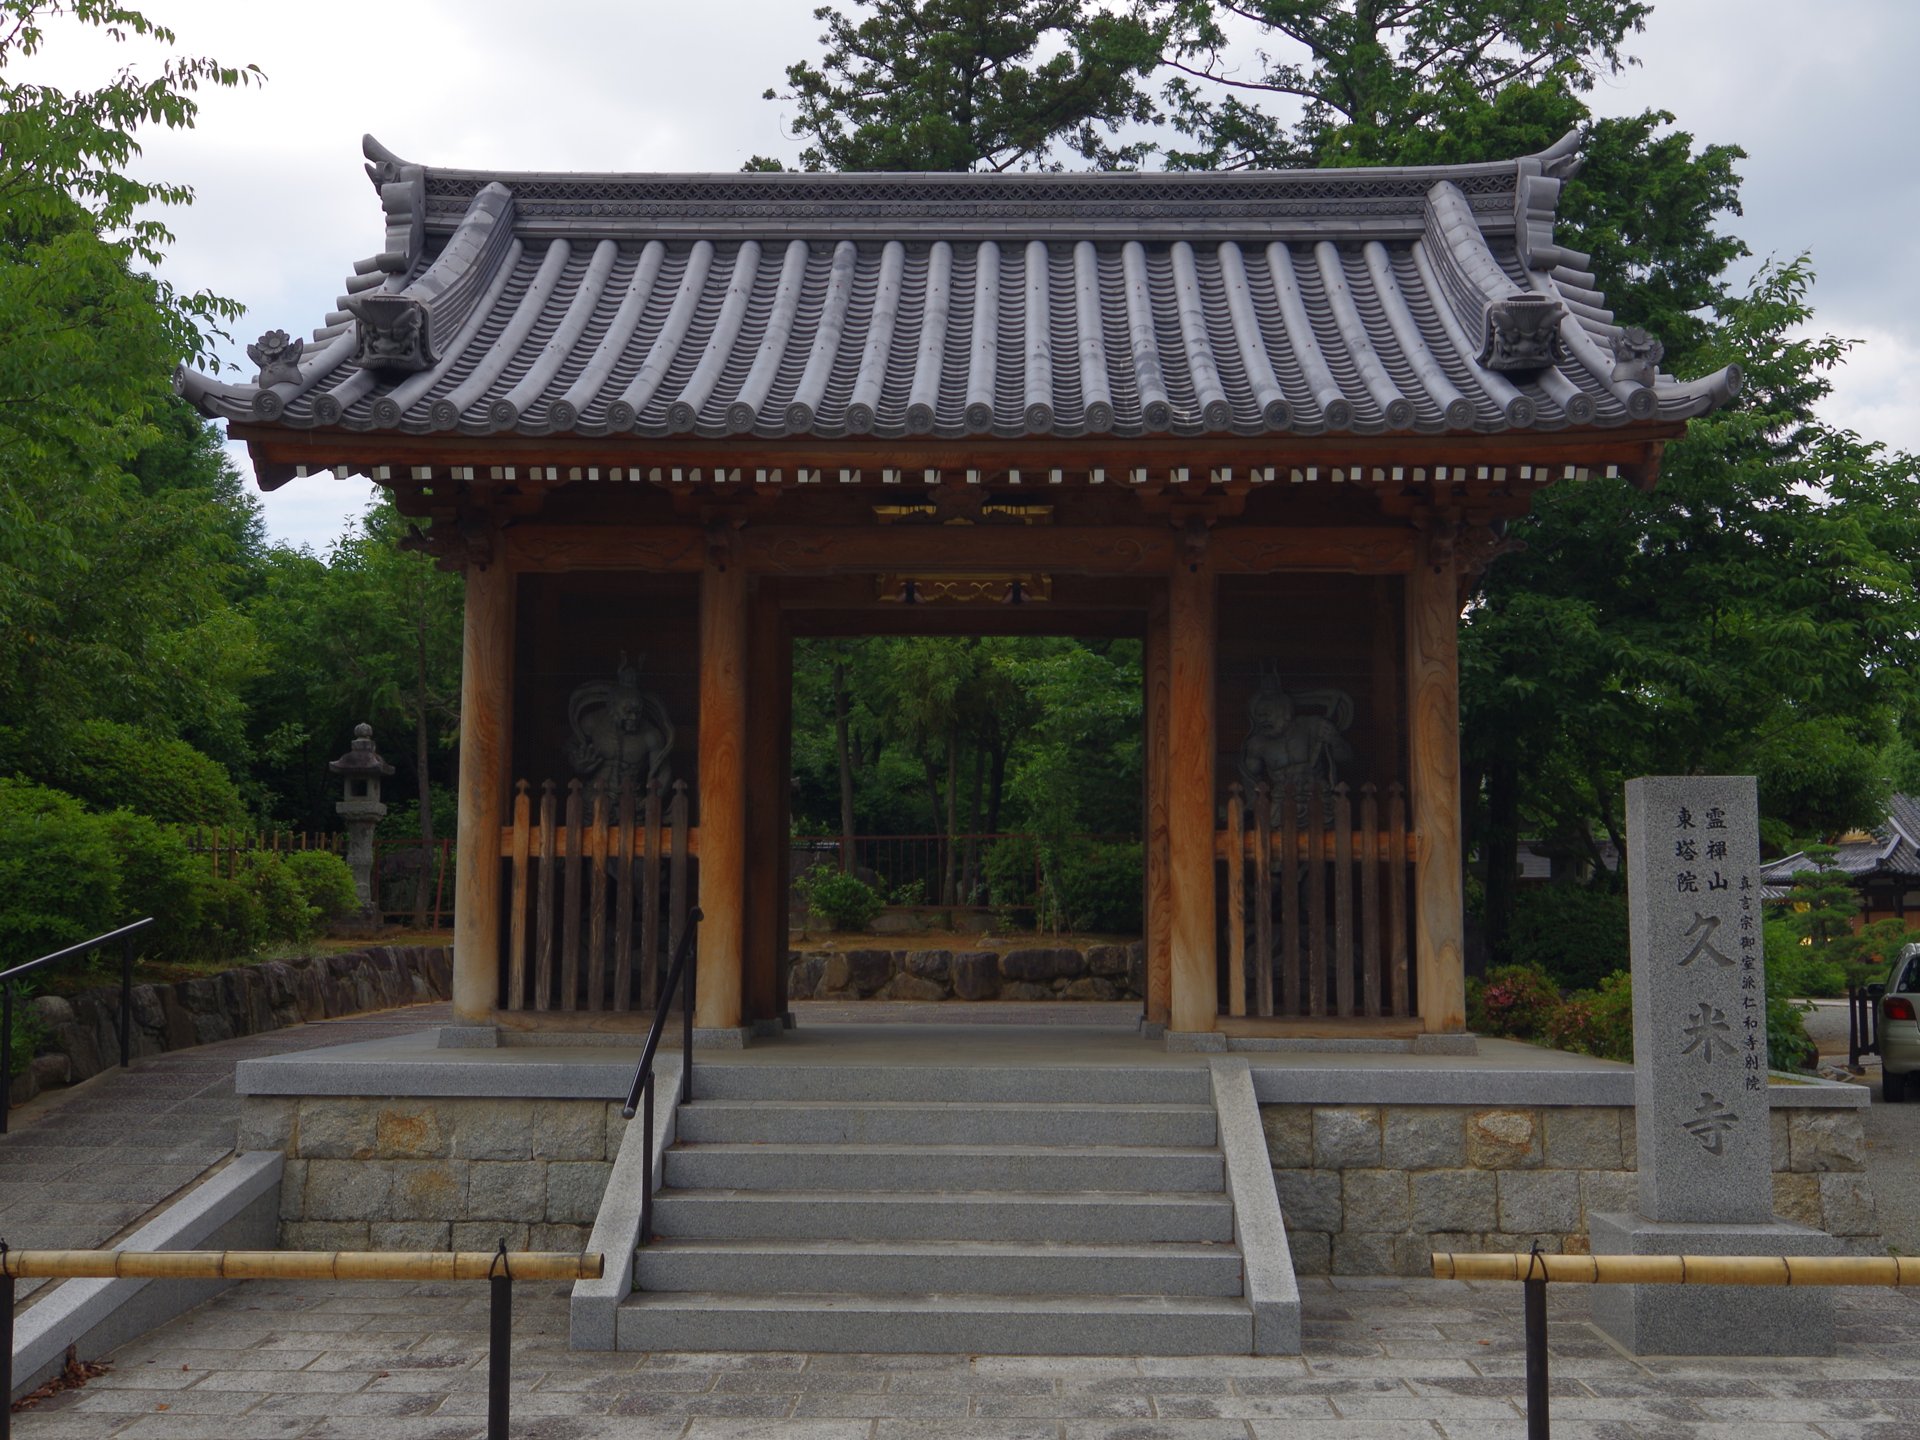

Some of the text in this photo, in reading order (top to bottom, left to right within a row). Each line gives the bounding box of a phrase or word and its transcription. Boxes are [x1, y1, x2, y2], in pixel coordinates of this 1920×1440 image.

[1675, 807, 1698, 893] 東塔院
[1678, 911, 1740, 1156] 久米寺
